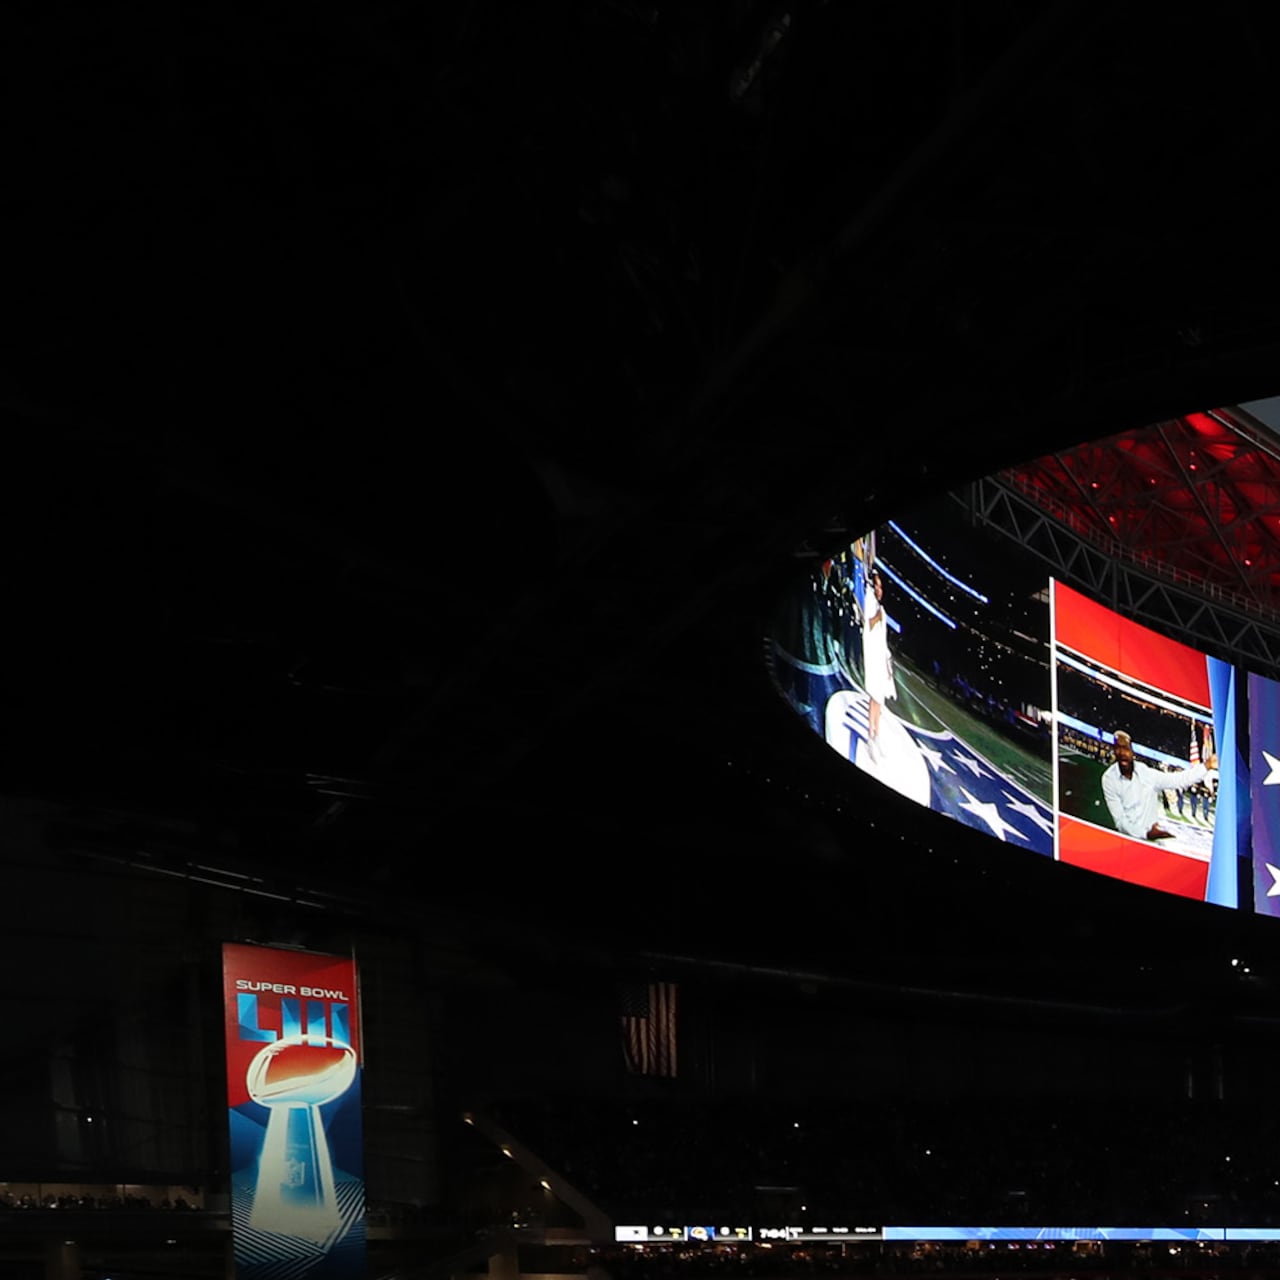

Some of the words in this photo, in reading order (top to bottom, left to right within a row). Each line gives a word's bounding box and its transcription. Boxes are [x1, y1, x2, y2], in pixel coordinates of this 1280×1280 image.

[236, 979, 297, 996] SUPER
[300, 986, 350, 1001] BOWL
[236, 992, 351, 1049] LIII
